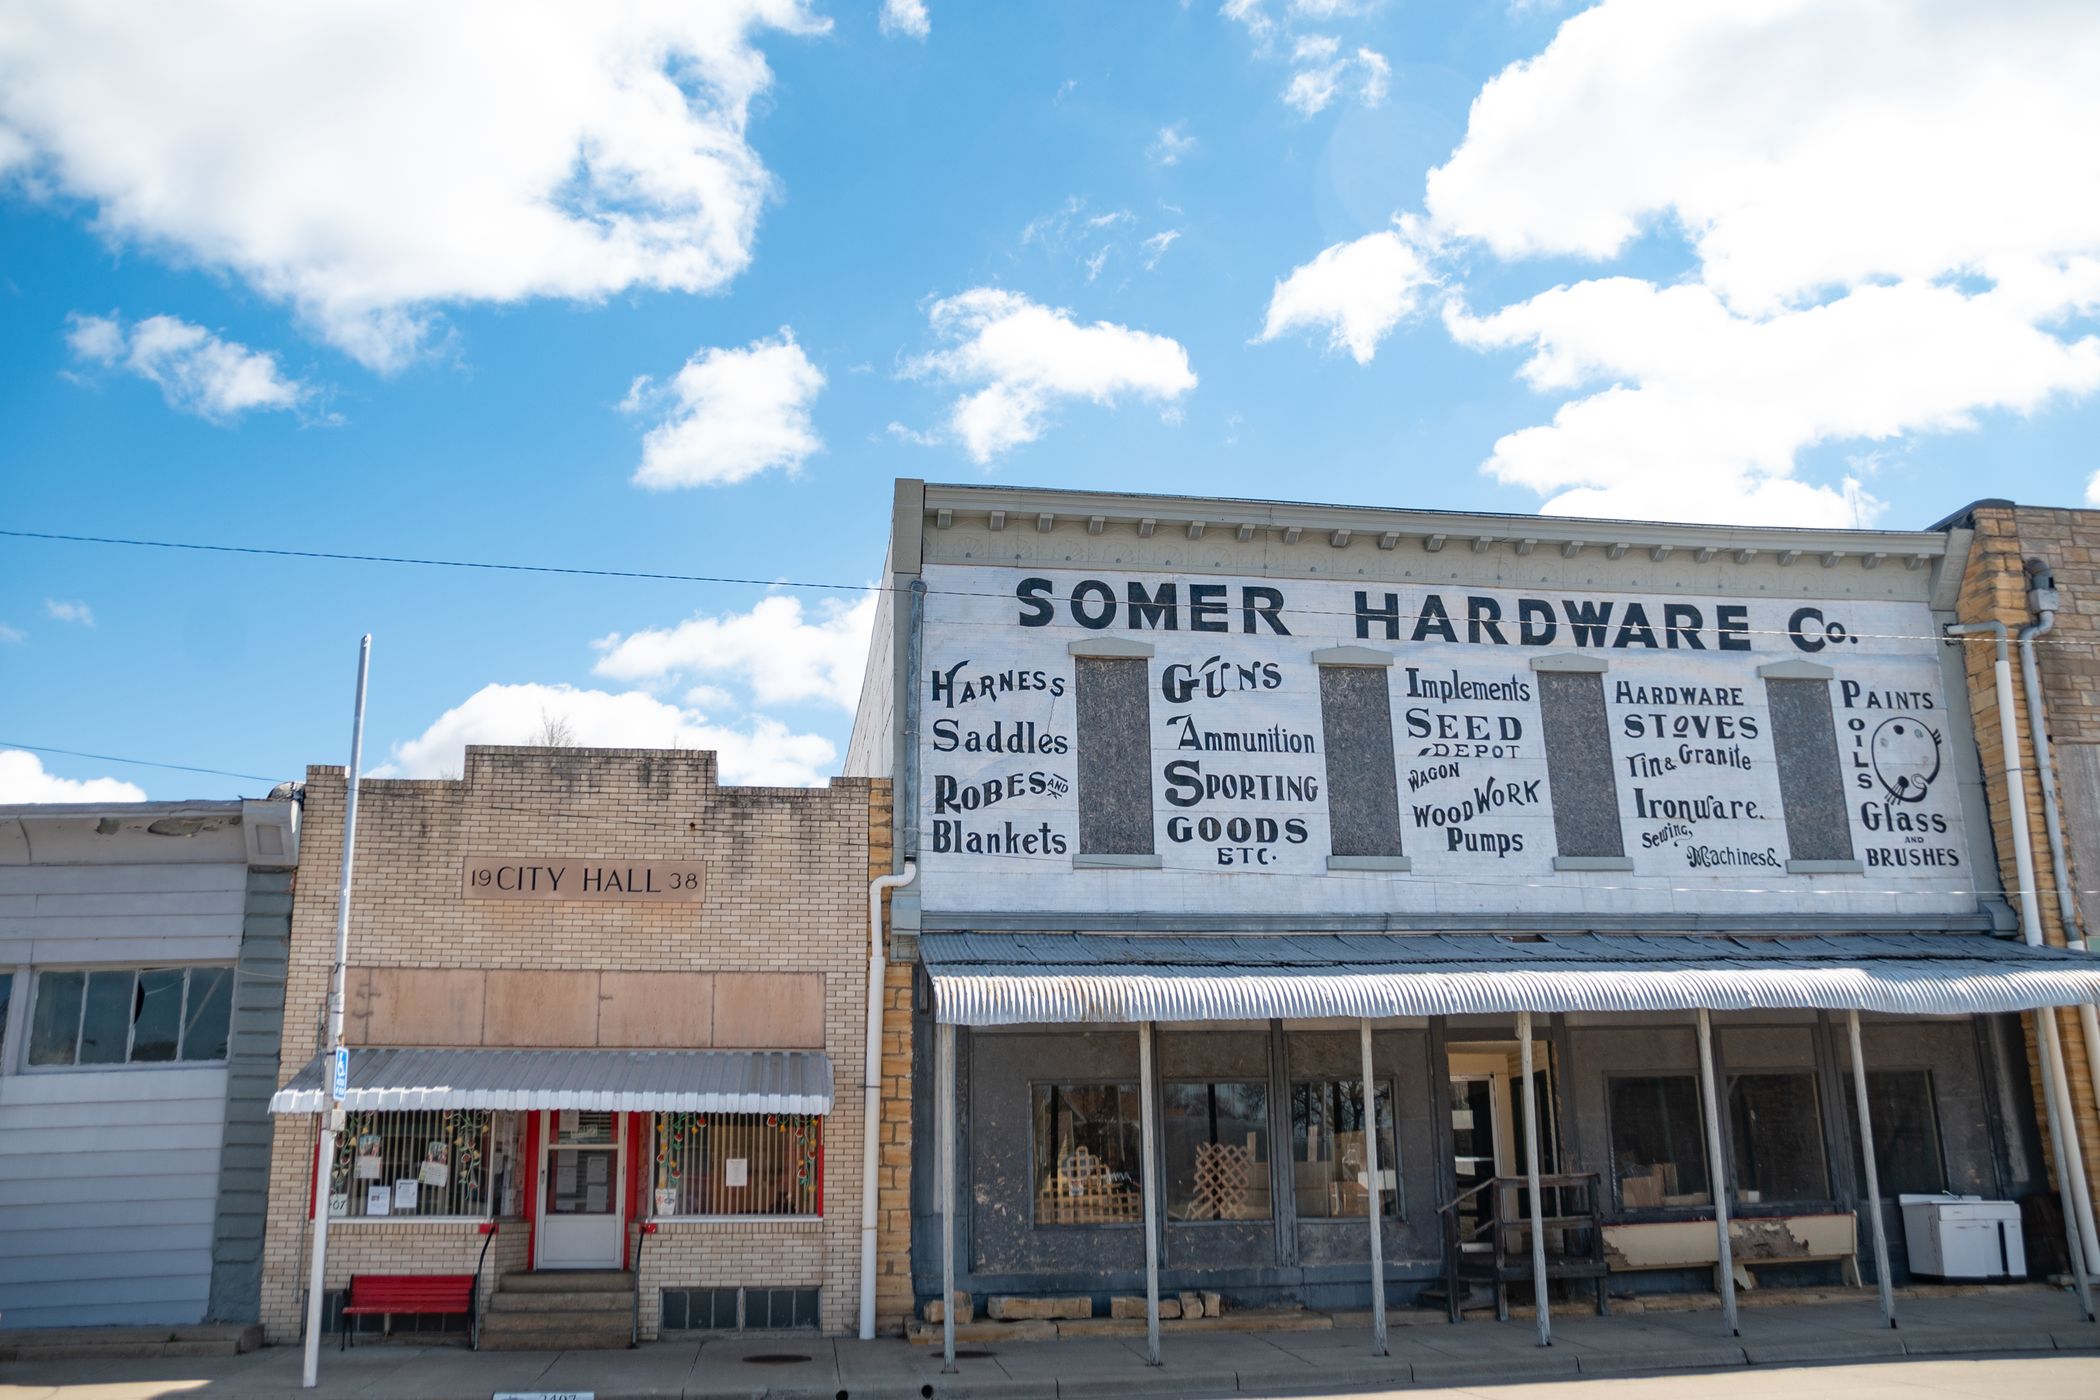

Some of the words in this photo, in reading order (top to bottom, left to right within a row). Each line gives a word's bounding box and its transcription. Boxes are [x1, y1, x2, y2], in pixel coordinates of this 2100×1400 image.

[1016, 577, 1292, 636] SOMER
[1354, 591, 1750, 651] HARDWARE
[932, 660, 1065, 708] HARNESS
[1162, 656, 1281, 703] GUNS
[1406, 668, 1530, 703] Implements
[1616, 681, 1743, 705] HARDWARE
[1840, 680, 1933, 709] PAINTS
[933, 719, 1068, 754] Saddles
[1167, 714, 1314, 753] Ammunition
[1406, 708, 1522, 740] SEED
[1625, 714, 1758, 739] STOVES
[1433, 744, 1519, 758] DEPOT
[1626, 753, 1663, 777] Tin
[1665, 757, 1676, 770] &
[1679, 744, 1751, 770] Granite
[1848, 719, 1874, 789] OILS
[935, 772, 1046, 814] ROBES
[1048, 777, 1068, 794] AND
[1164, 760, 1318, 807] SPORTING
[1408, 762, 1459, 792] WAGON
[1167, 817, 1307, 843] GOODS
[1861, 802, 1947, 833] Glass
[933, 820, 1066, 854] Blankets
[1447, 827, 1523, 858] Pumps
[1218, 848, 1276, 865] ETC.
[1866, 848, 1959, 866] BRUSHES
[472, 870, 491, 886] 19
[497, 866, 565, 891] CITY
[583, 868, 661, 892] HALL
[669, 873, 697, 889] 38
